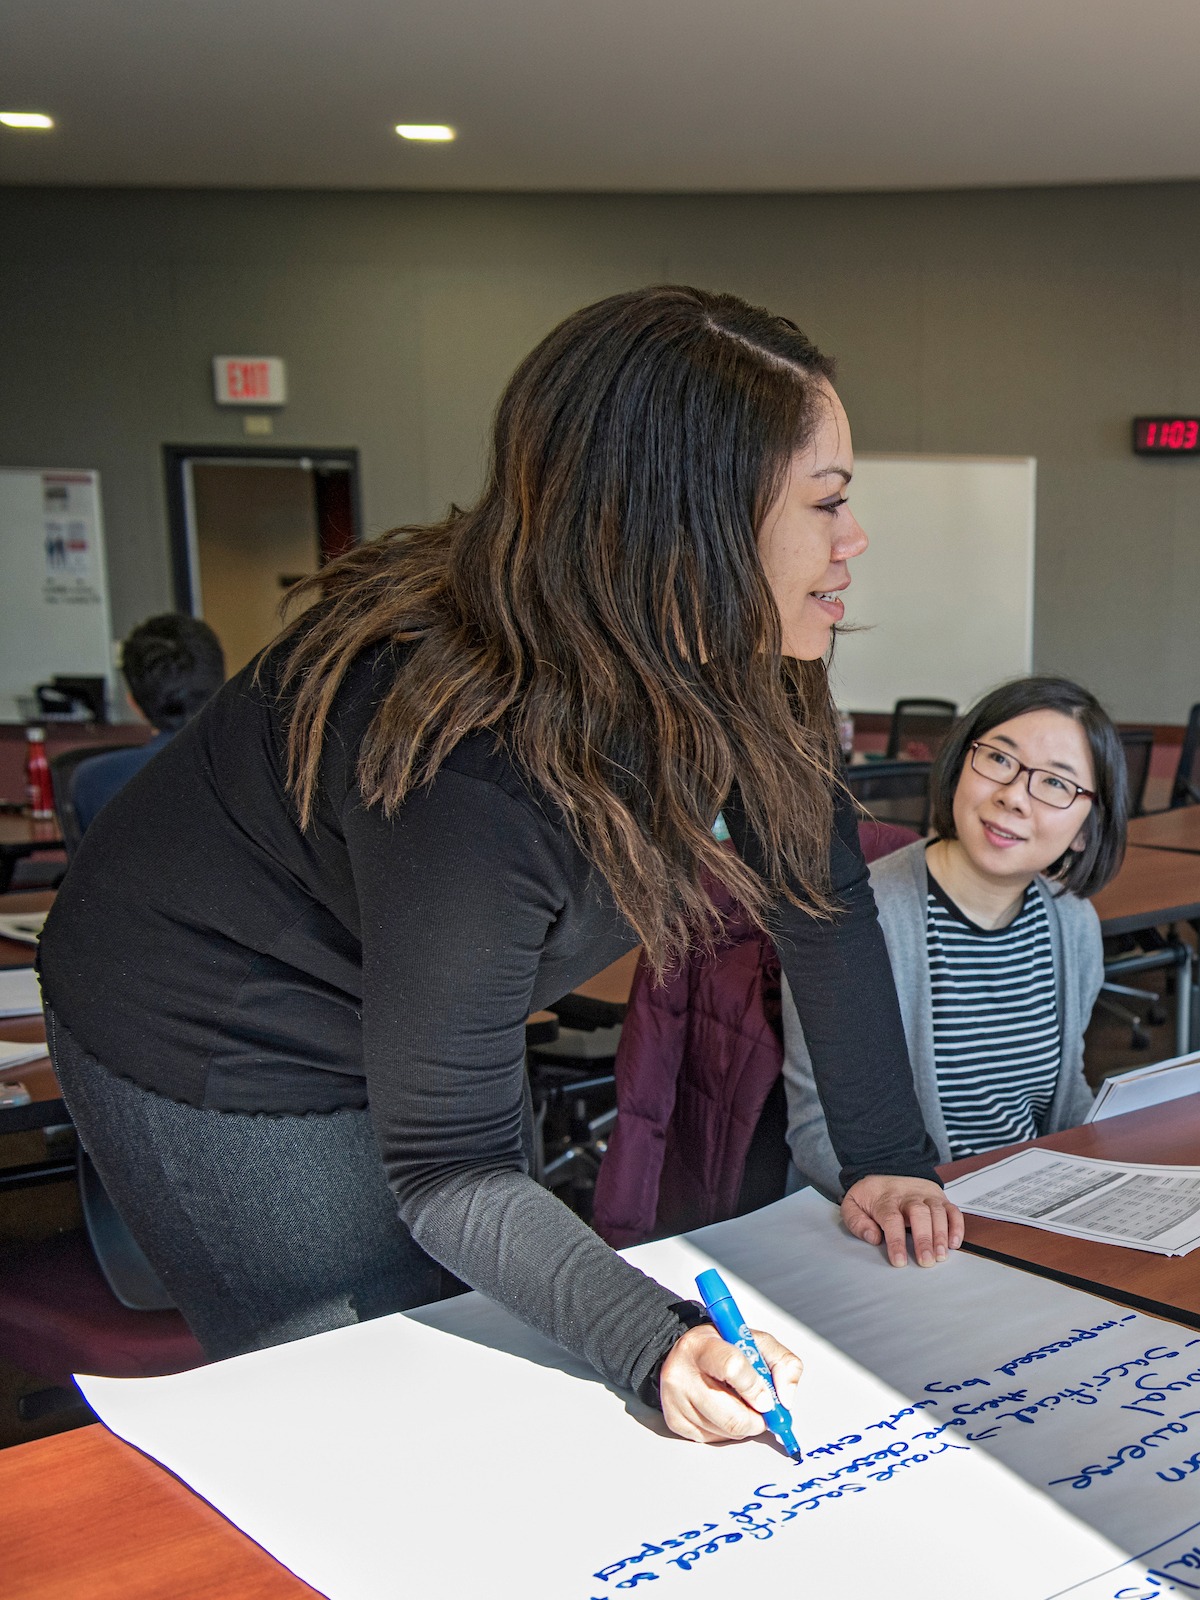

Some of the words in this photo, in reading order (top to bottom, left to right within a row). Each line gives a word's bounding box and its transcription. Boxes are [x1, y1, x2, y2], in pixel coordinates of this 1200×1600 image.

[227, 361, 269, 397] EXIT
[924, 1377, 991, 1393] by
[864, 1400, 938, 1430] work
[952, 1389, 1028, 1415] they
[912, 1418, 967, 1440] are
[867, 1443, 971, 1481] have
[1048, 1421, 1188, 1489] averse
[729, 1502, 763, 1524] of
[615, 1572, 660, 1588] so
